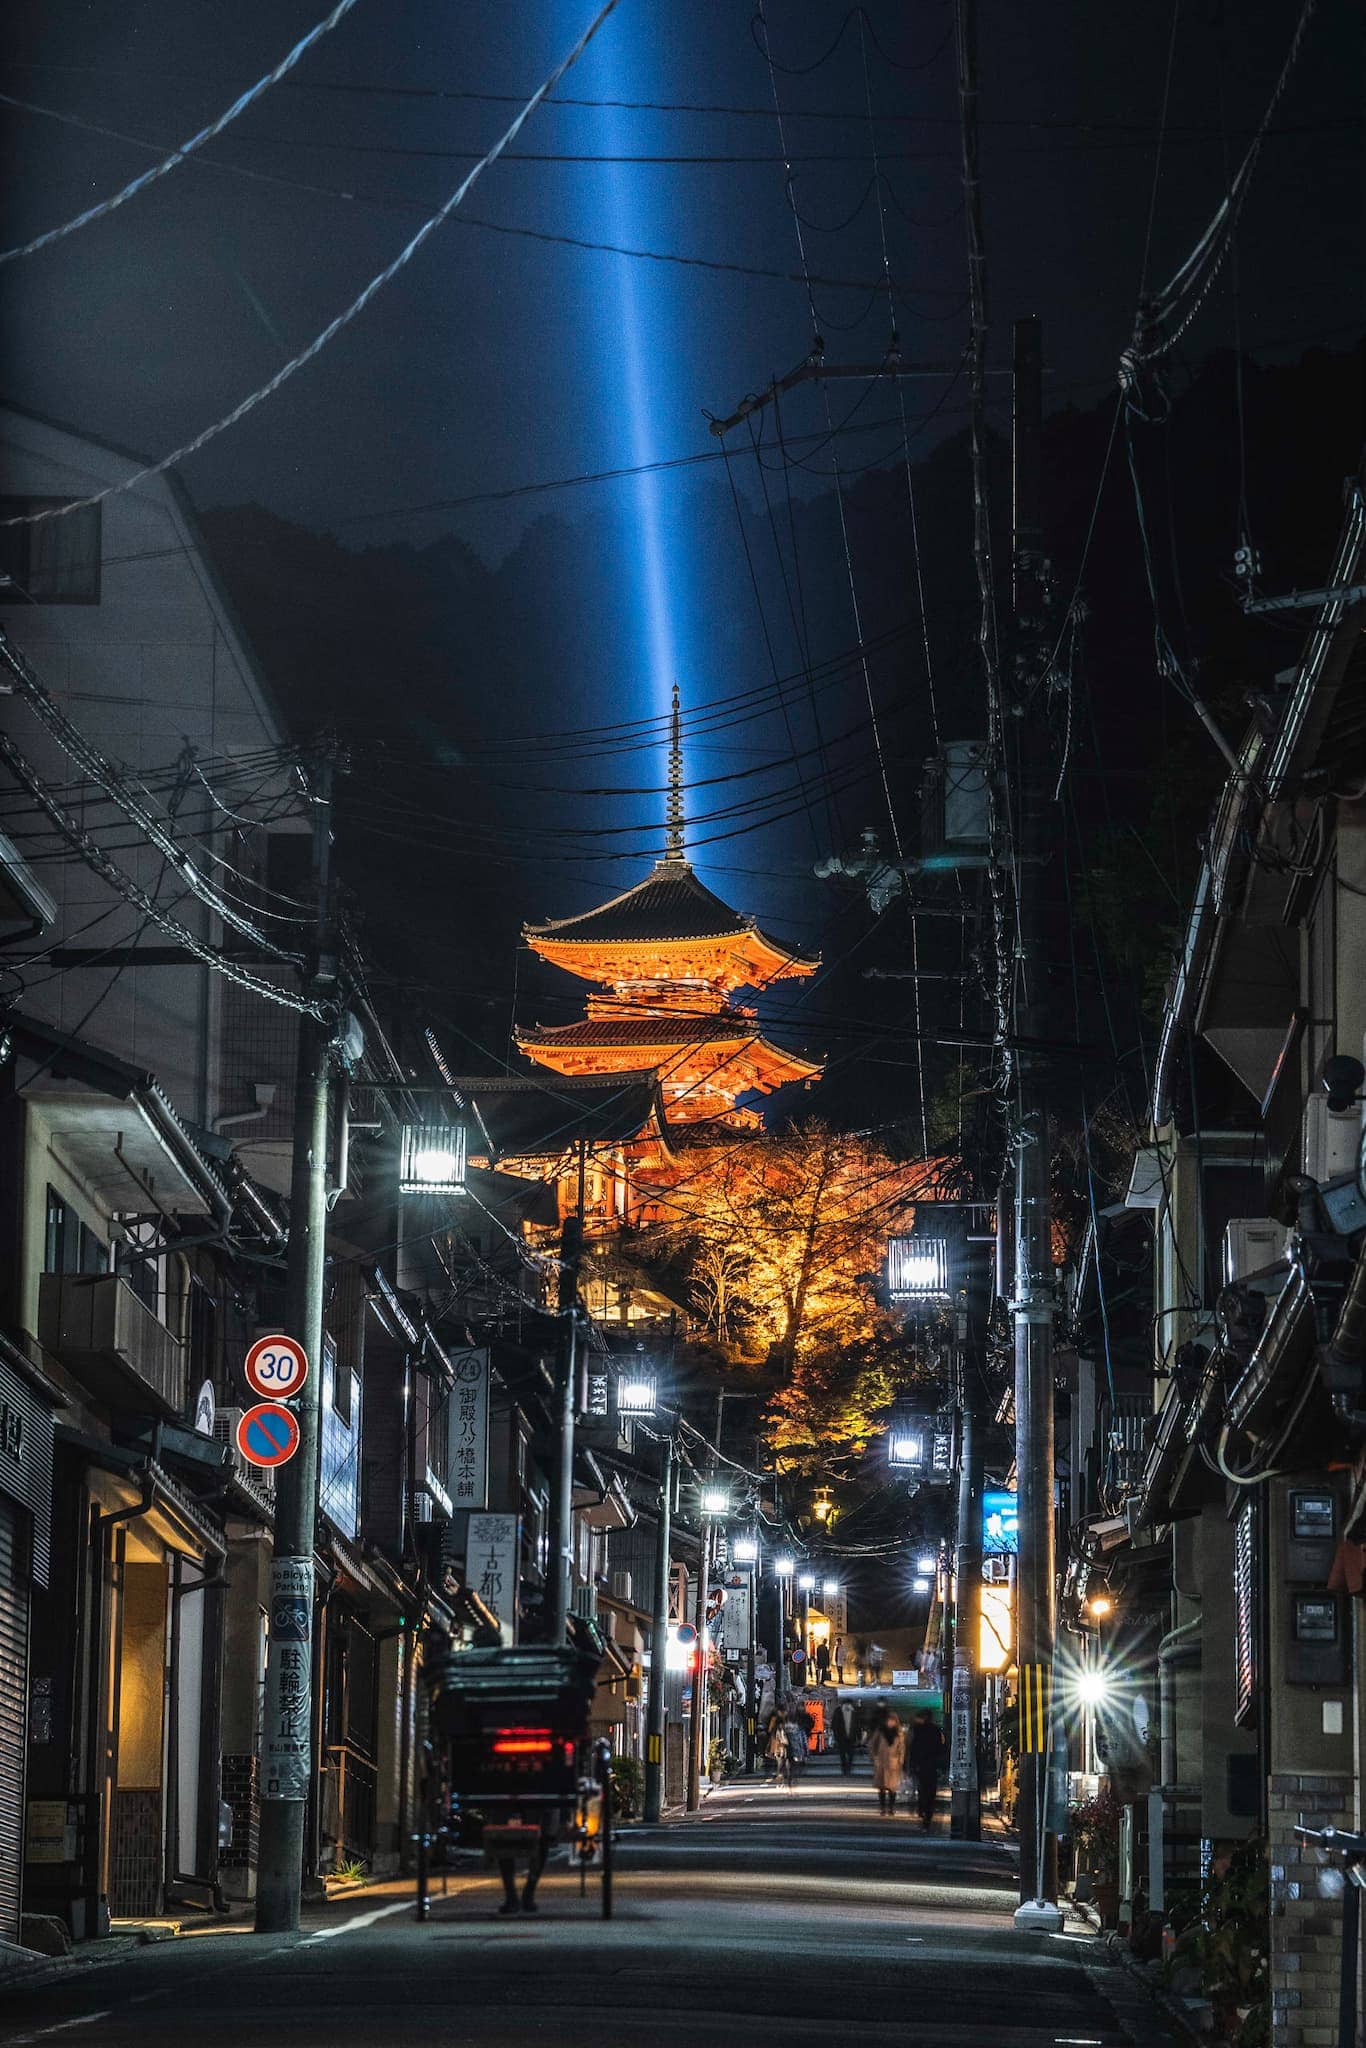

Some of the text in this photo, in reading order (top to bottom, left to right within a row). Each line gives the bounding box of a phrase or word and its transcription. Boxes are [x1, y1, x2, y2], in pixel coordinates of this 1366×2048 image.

[259, 1353, 293, 1381] 30
[457, 1388, 477, 1497] 御殿八ツ橋本舗
[275, 1582, 309, 1594] Parking
[278, 1650, 301, 1738] 駐輪禁止
